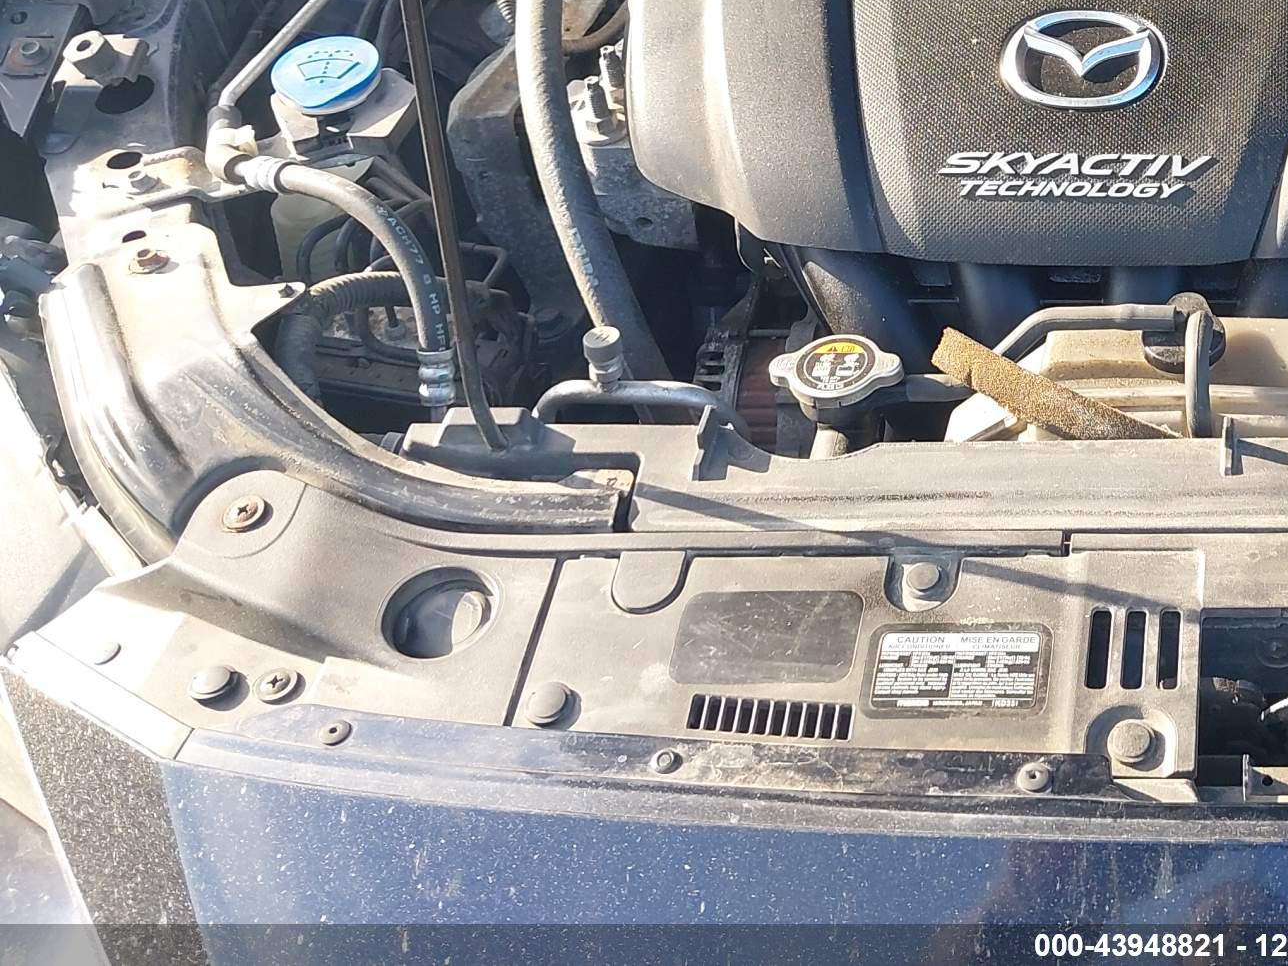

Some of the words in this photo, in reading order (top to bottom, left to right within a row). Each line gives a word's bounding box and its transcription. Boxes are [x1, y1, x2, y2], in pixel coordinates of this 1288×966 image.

[938, 151, 1211, 177] SKYACTIV
[960, 180, 1185, 199] TECHNOLOGY
[897, 636, 946, 644] CAUTION
[960, 636, 984, 644] MISE
[986, 636, 1001, 644] EN
[1001, 636, 1036, 644] GARDE
